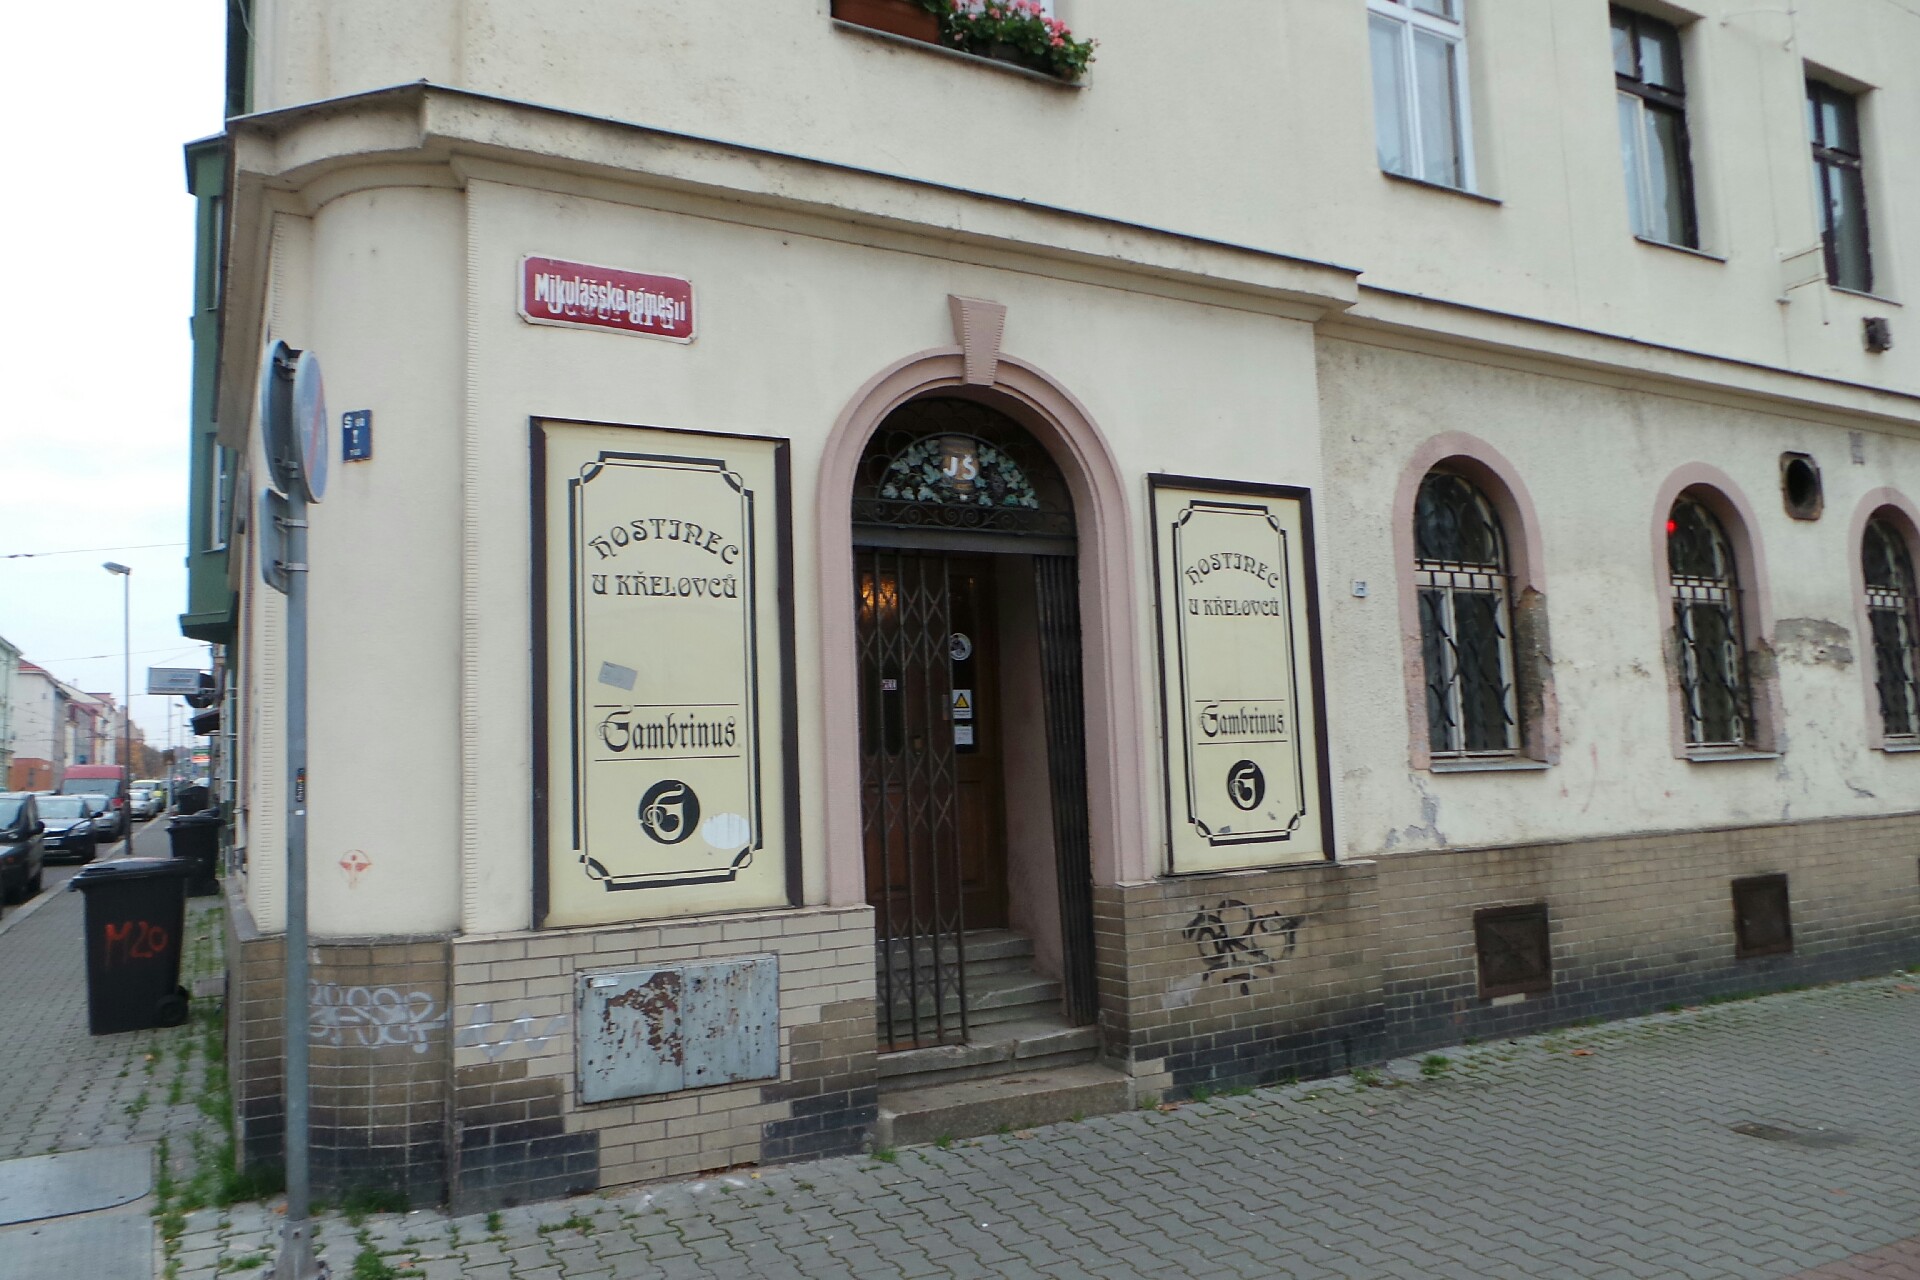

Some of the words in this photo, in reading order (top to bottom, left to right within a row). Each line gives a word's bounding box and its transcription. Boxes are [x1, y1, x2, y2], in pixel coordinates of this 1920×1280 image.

[588, 518, 739, 565] HOSTINEC
[592, 574, 608, 596] U
[615, 569, 738, 599] KŘELOVCŮ
[1184, 552, 1279, 589] HOSTINEC
[1188, 598, 1200, 616] U
[1202, 596, 1280, 617] KŘELOVCŮ
[595, 705, 737, 753] Gambrinus
[1200, 704, 1284, 738] Gambrinus
